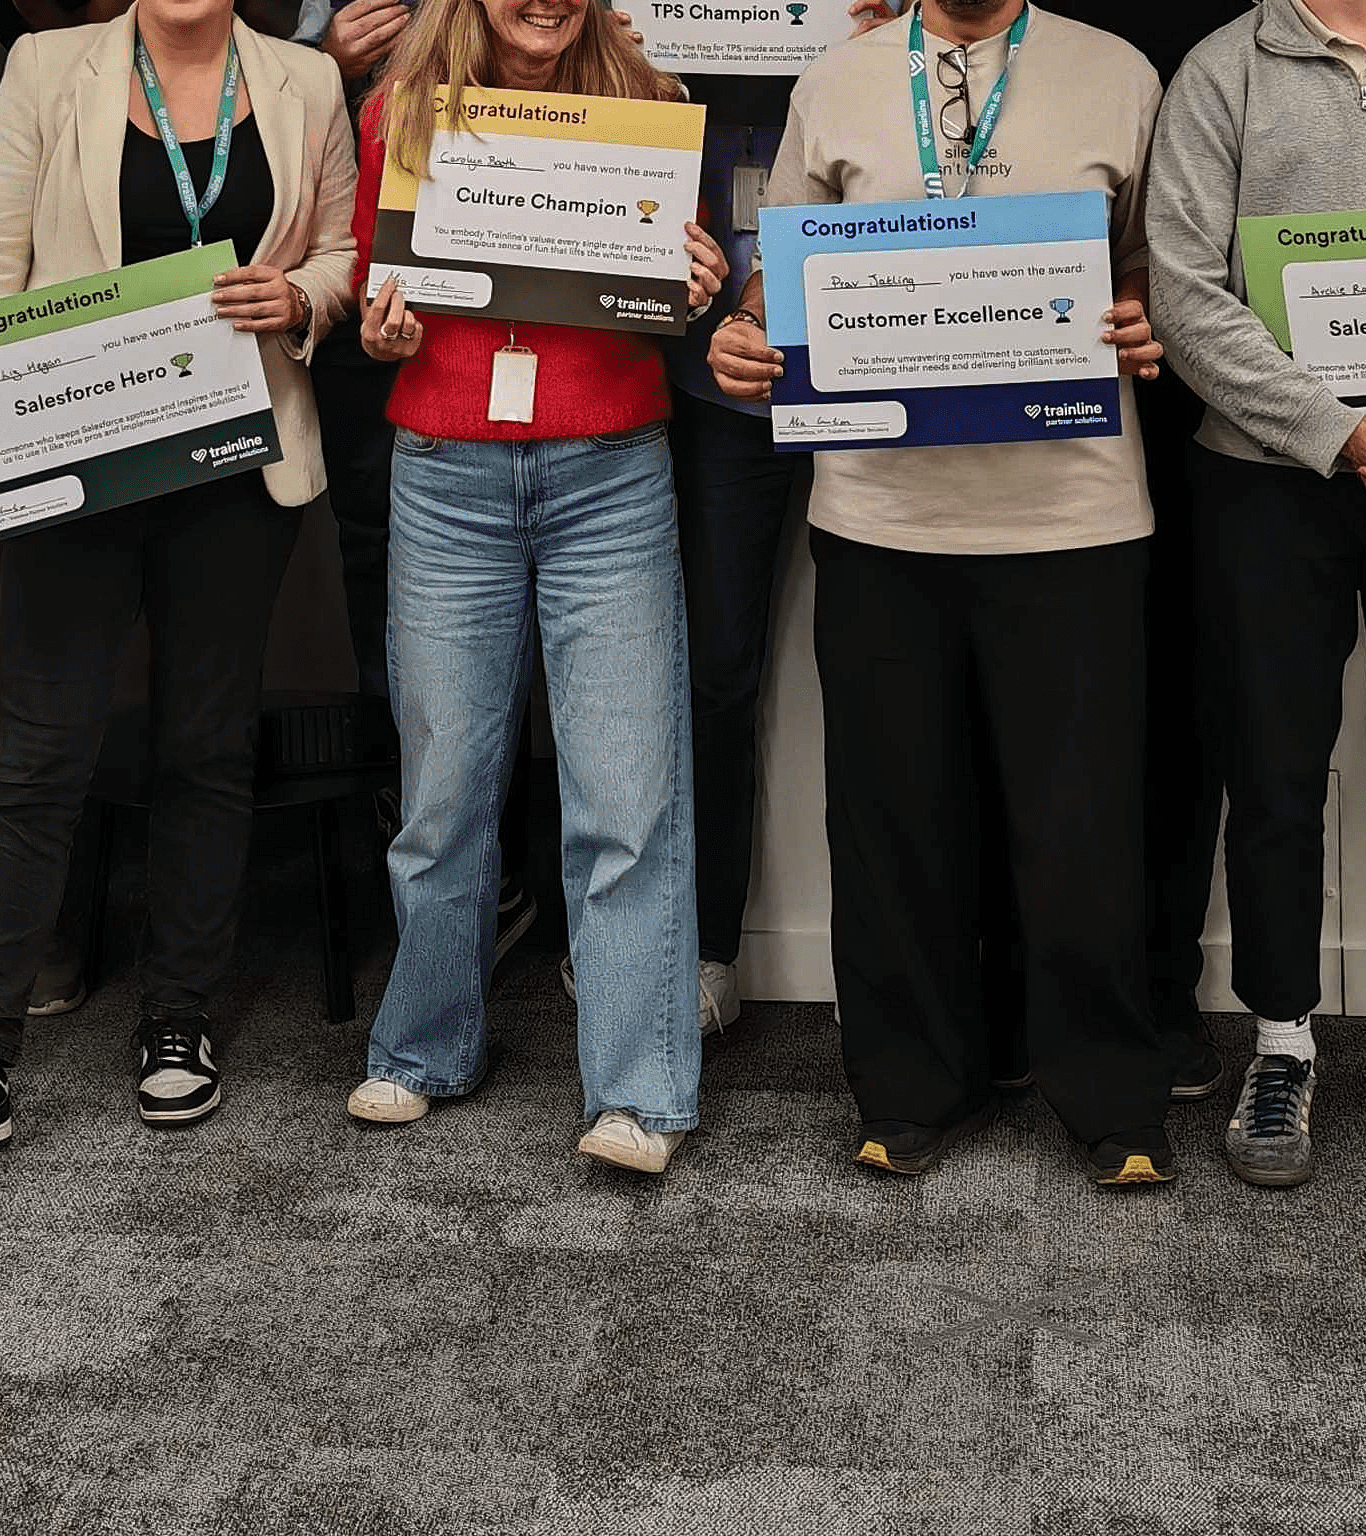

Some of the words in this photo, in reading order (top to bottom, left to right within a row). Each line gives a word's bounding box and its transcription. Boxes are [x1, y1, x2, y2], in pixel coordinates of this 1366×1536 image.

[650, 3, 684, 19] TPS
[689, 4, 780, 24] Champion
[553, 162, 572, 171] you
[573, 161, 598, 173] have
[599, 166, 621, 176] won
[623, 166, 641, 177] the
[642, 169, 676, 180] award:
[456, 186, 526, 208] Culture
[530, 193, 627, 218] Champion
[801, 211, 977, 240] Congratulations!
[949, 271, 969, 283] you
[971, 268, 998, 279] have
[1000, 268, 1025, 277] won
[1027, 265, 1046, 277] the
[1048, 262, 1086, 275] award:
[1311, 286, 1344, 295] Archie
[616, 297, 672, 313] trainline
[828, 312, 928, 330] Customer
[933, 304, 1044, 325] Excellence
[101, 340, 121, 353] you
[122, 332, 148, 345] have
[149, 326, 172, 338] won
[173, 321, 191, 332] the
[193, 314, 223, 327] awar
[14, 380, 116, 416] Salesforce
[119, 366, 167, 389] Hero
[1043, 401, 1103, 417] trainline
[208, 436, 263, 458] trainline
